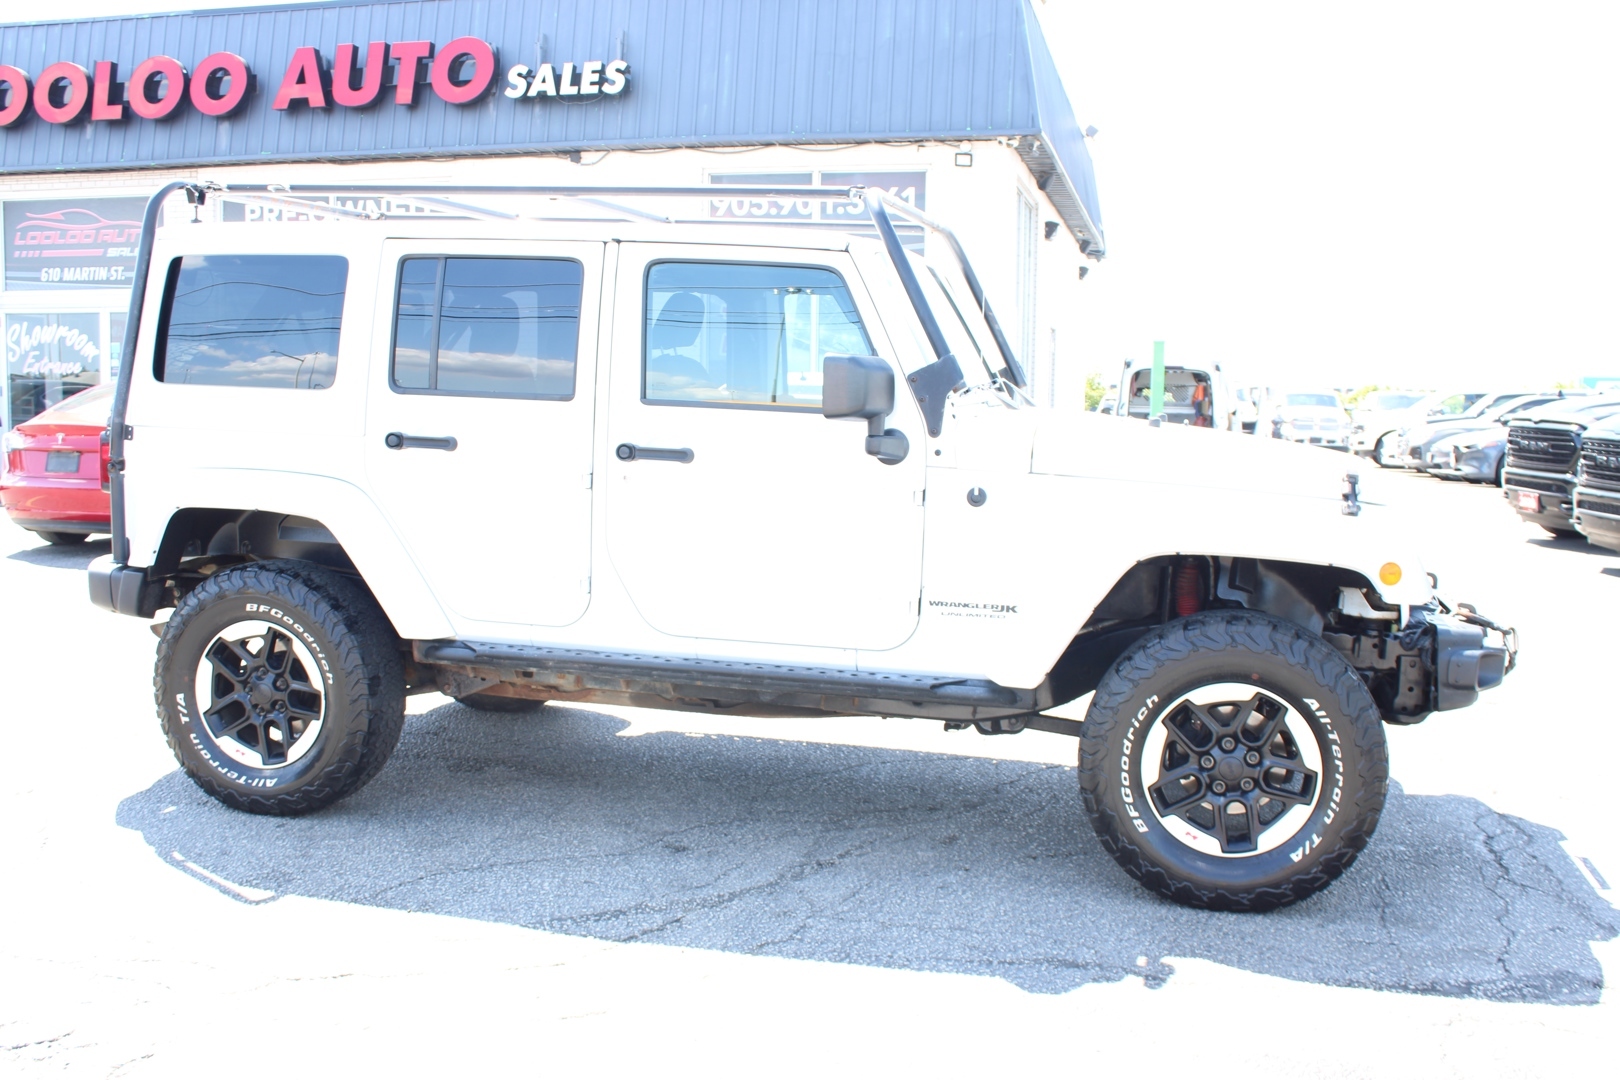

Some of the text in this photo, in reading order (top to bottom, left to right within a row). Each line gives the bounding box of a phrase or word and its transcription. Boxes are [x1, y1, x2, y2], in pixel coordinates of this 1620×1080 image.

[272, 35, 495, 111] AUTO
[504, 59, 628, 99] SALES
[14, 228, 142, 246] LOOLOO AUT
[40, 266, 126, 283] 610 MARTIN ST.
[7, 321, 100, 363] Showroom
[23, 351, 83, 375] Entrance
[941, 611, 1006, 620] UNLIMITED
[245, 602, 334, 685] BFGoodrich
[175, 692, 191, 725] T/A
[1120, 694, 1159, 834] BFGoodrich
[1289, 832, 1323, 863] T/A
